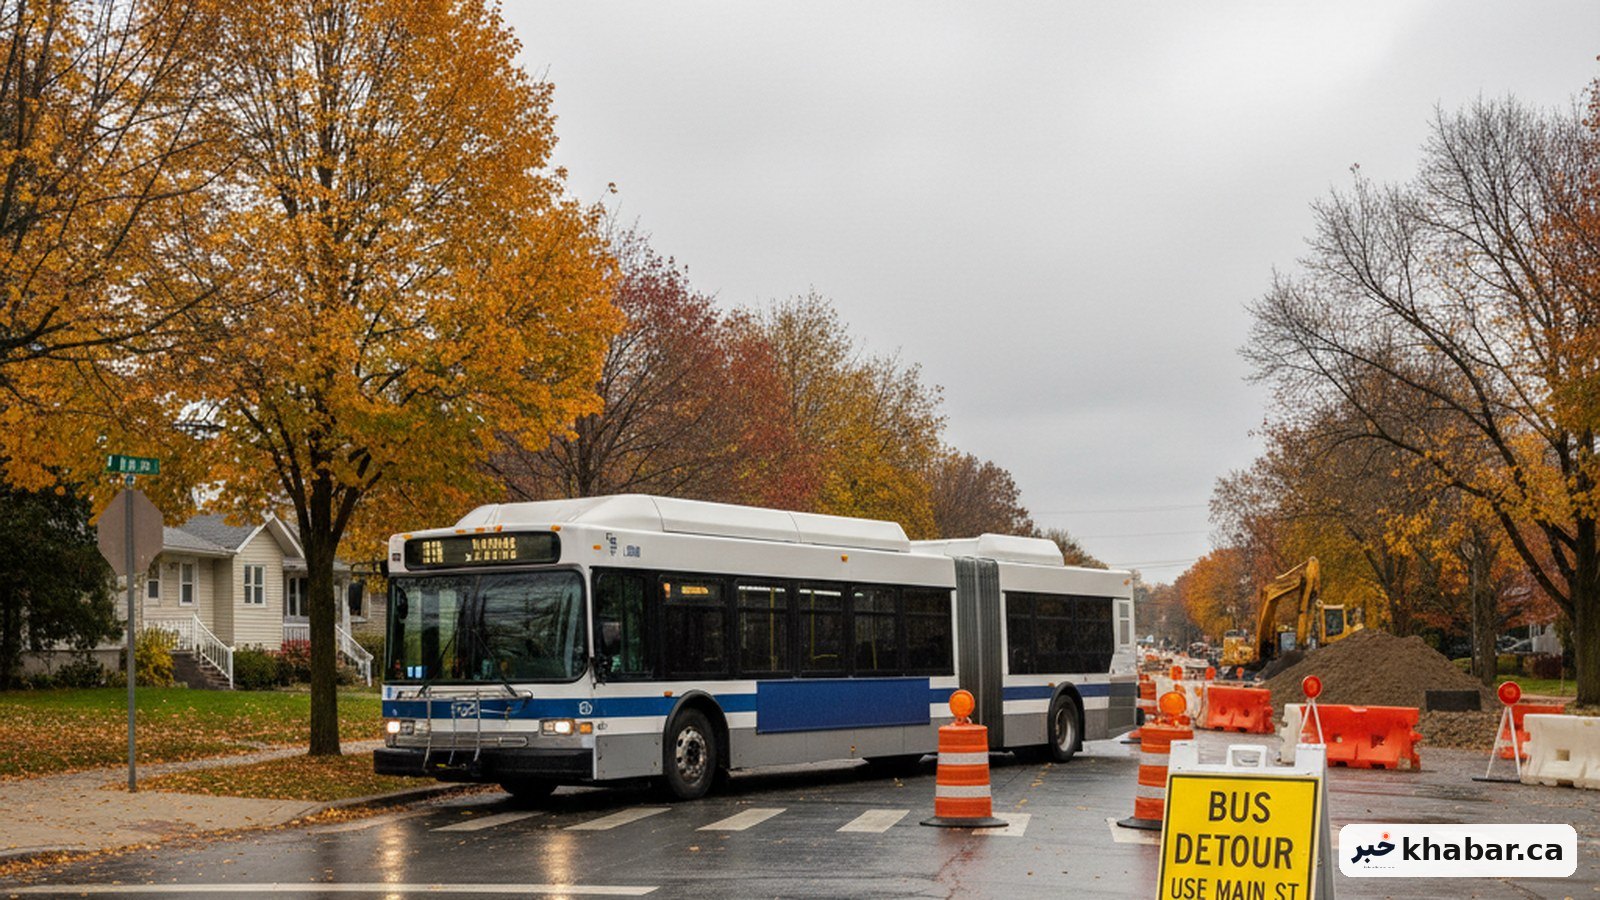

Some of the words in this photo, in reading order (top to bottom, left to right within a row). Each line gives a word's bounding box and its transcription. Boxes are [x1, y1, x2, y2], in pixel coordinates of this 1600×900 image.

[1208, 791, 1271, 823] BUS
[1174, 833, 1294, 870] DETOUR
[1171, 877, 1207, 900] USE
[1215, 879, 1265, 900] MAIN
[1274, 882, 1299, 900] ST
